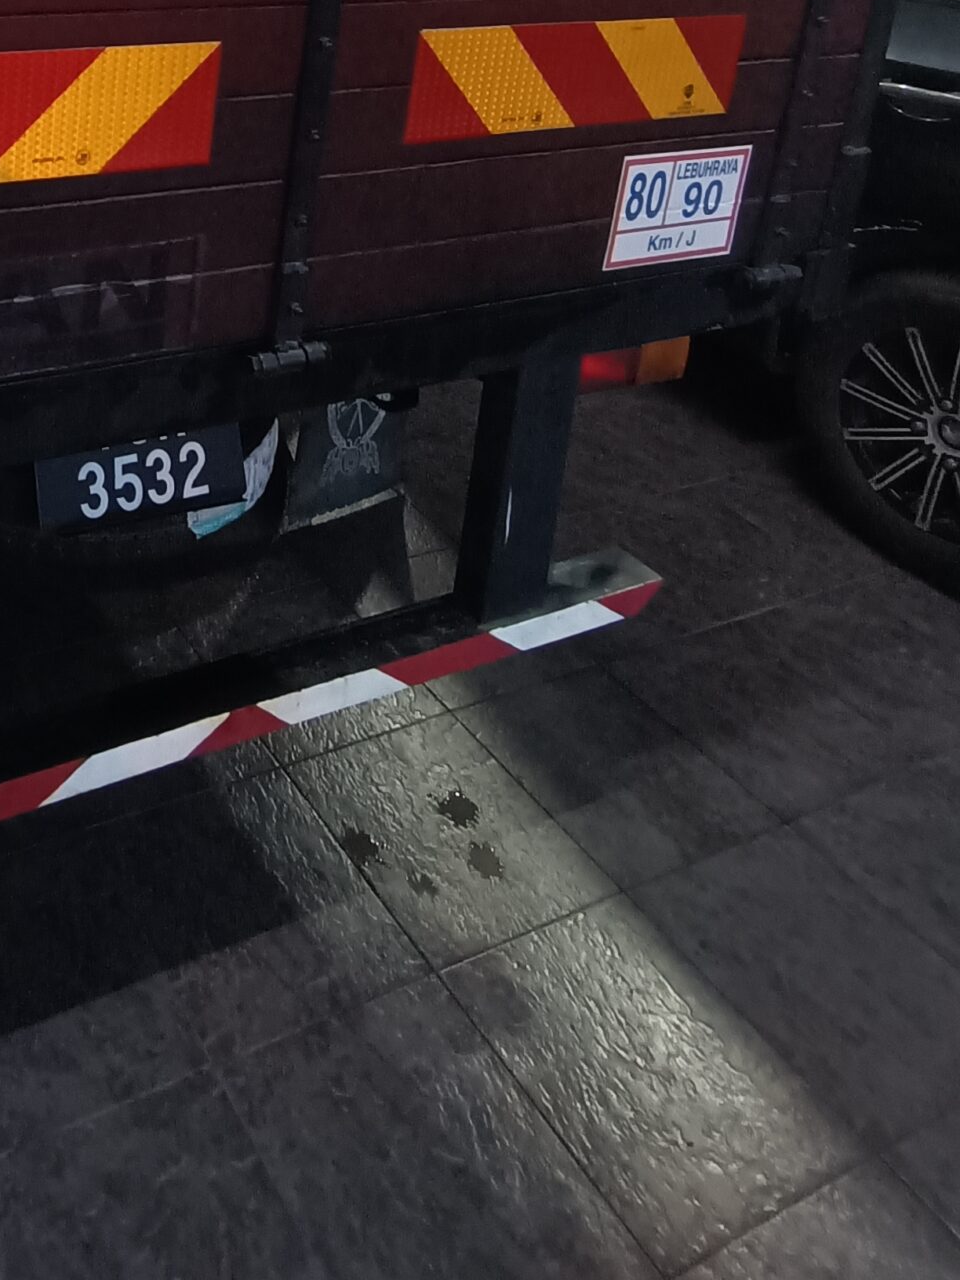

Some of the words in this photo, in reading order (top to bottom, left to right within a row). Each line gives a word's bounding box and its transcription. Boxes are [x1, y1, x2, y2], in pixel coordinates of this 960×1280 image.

[677, 158, 739, 180] LEBUHRAYA
[625, 170, 667, 221] 80
[682, 179, 723, 218] 90
[647, 235, 672, 252] Km
[77, 440, 210, 519] 3532
